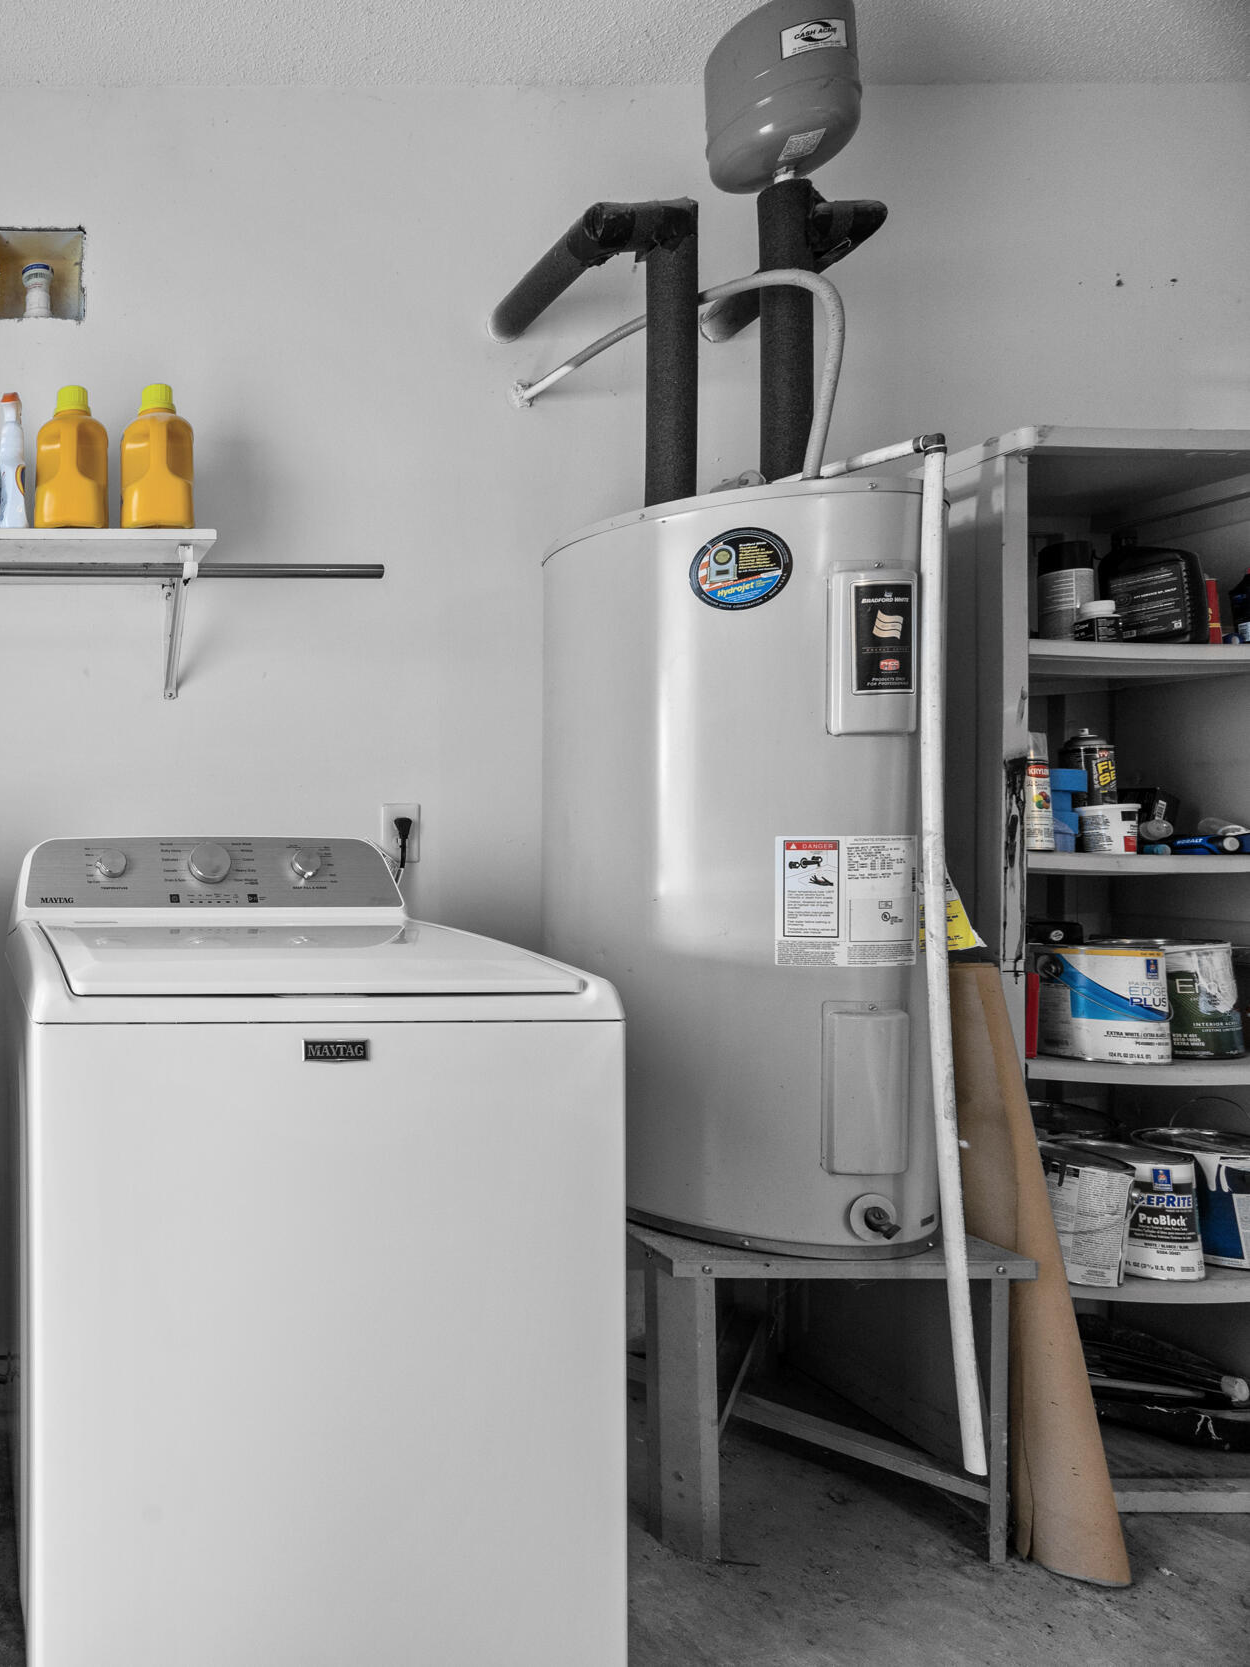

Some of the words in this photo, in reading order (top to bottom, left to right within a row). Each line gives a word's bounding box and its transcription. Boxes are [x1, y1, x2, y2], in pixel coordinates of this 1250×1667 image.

[794, 29, 816, 40] CASH
[717, 582, 755, 598] Hydrojet
[1129, 986, 1167, 997] EDGE
[1129, 996, 1167, 1007] PLUS
[307, 1044, 365, 1057] MAYTAG
[1138, 1213, 1187, 1227] ProBlock
